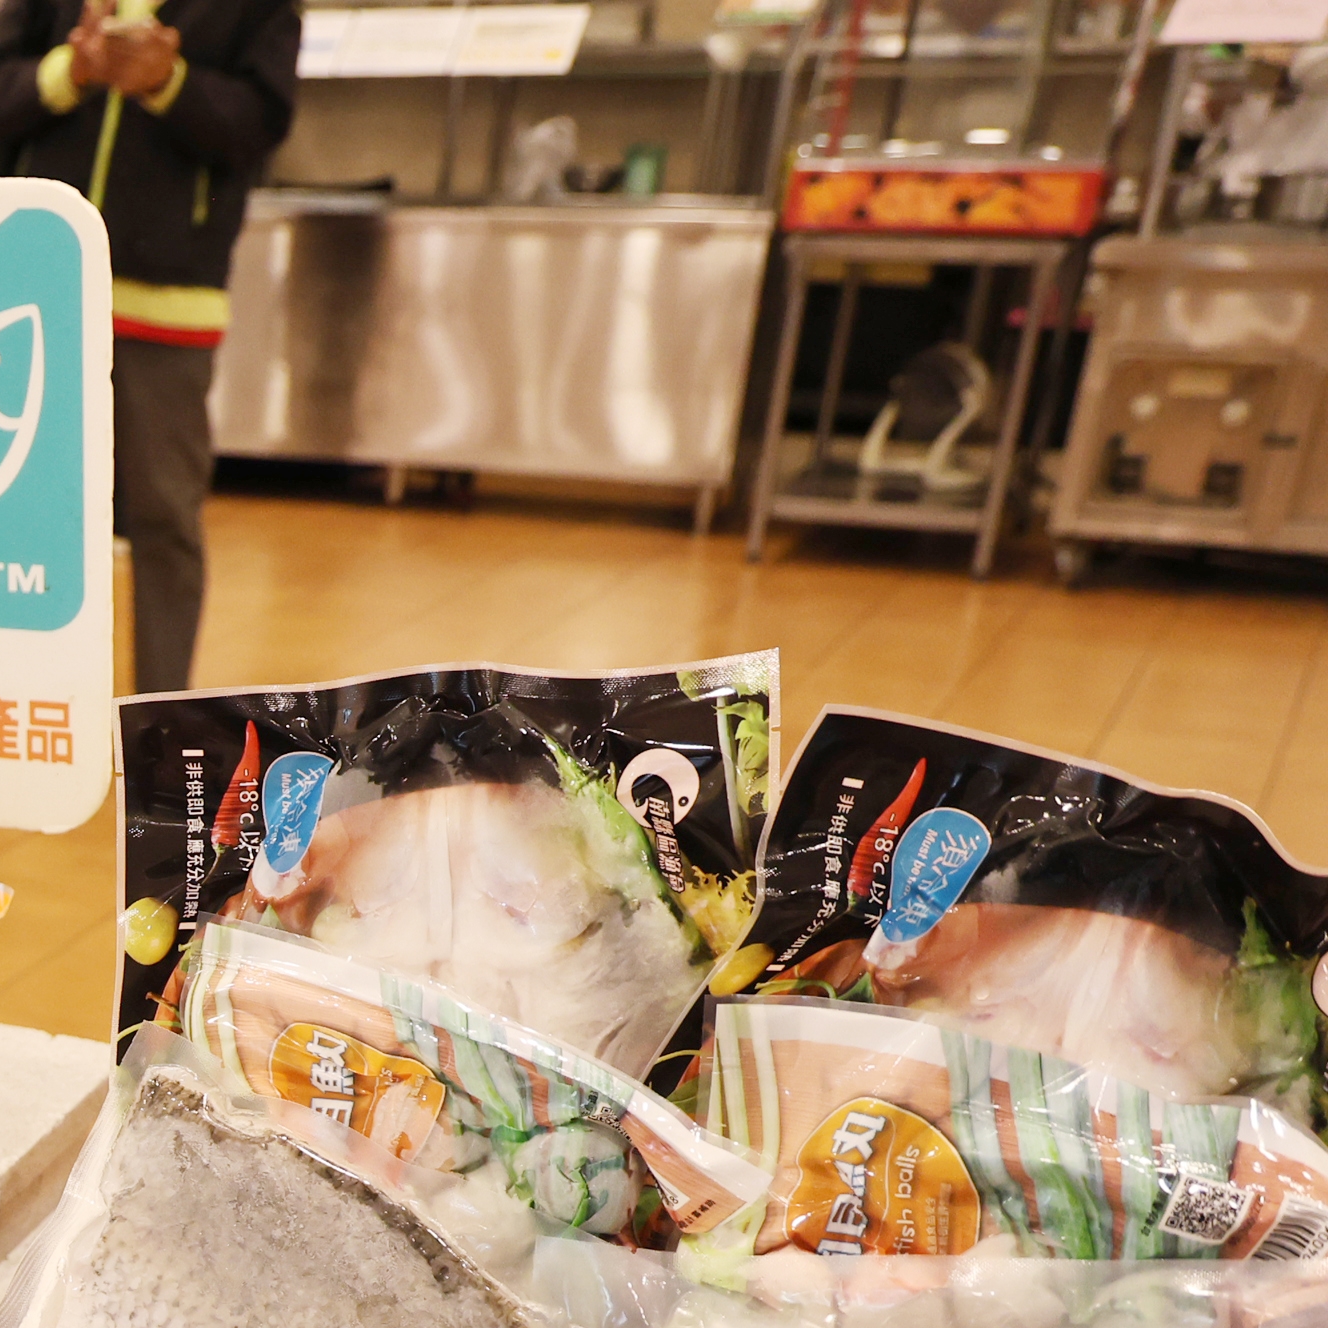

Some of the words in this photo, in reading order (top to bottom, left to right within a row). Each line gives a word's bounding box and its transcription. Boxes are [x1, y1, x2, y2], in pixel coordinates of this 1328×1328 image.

[917, 828, 939, 859] Must
[893, 1143, 921, 1199] balls
[893, 1208, 916, 1256] fish
